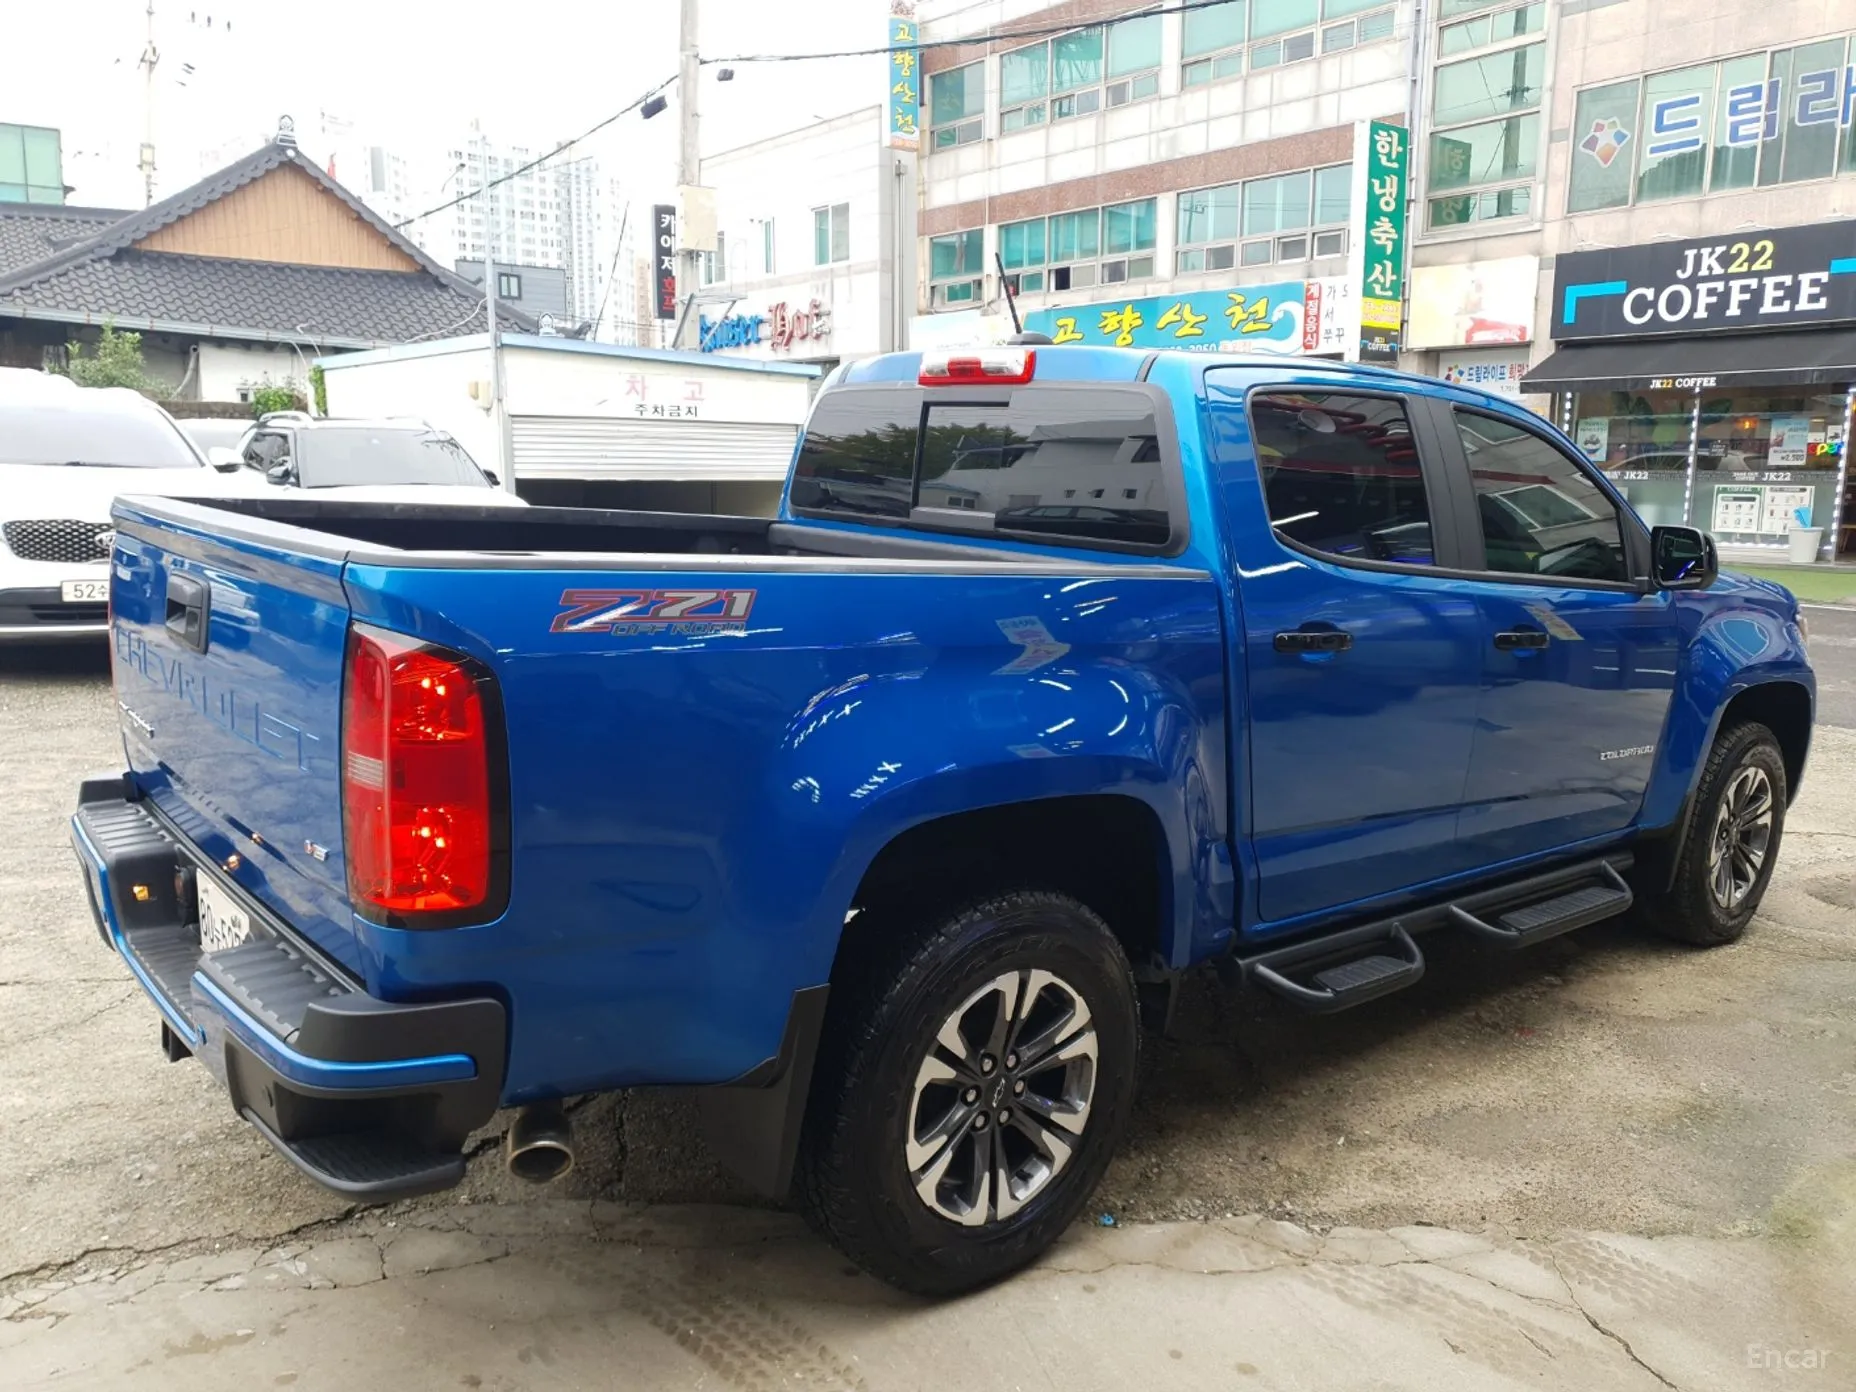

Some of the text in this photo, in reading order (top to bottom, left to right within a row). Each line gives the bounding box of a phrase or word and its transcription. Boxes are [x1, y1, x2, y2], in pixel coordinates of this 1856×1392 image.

[1367, 129, 1403, 296] 한냉축산
[1676, 239, 1775, 279] JK22
[1622, 271, 1829, 325] COFFEE
[1051, 293, 1273, 346] 고향산천
[1674, 376, 1717, 388] COFFEE
[634, 403, 698, 417] 주차금지
[1762, 471, 1791, 481] JK22
[550, 588, 757, 633] Z71
